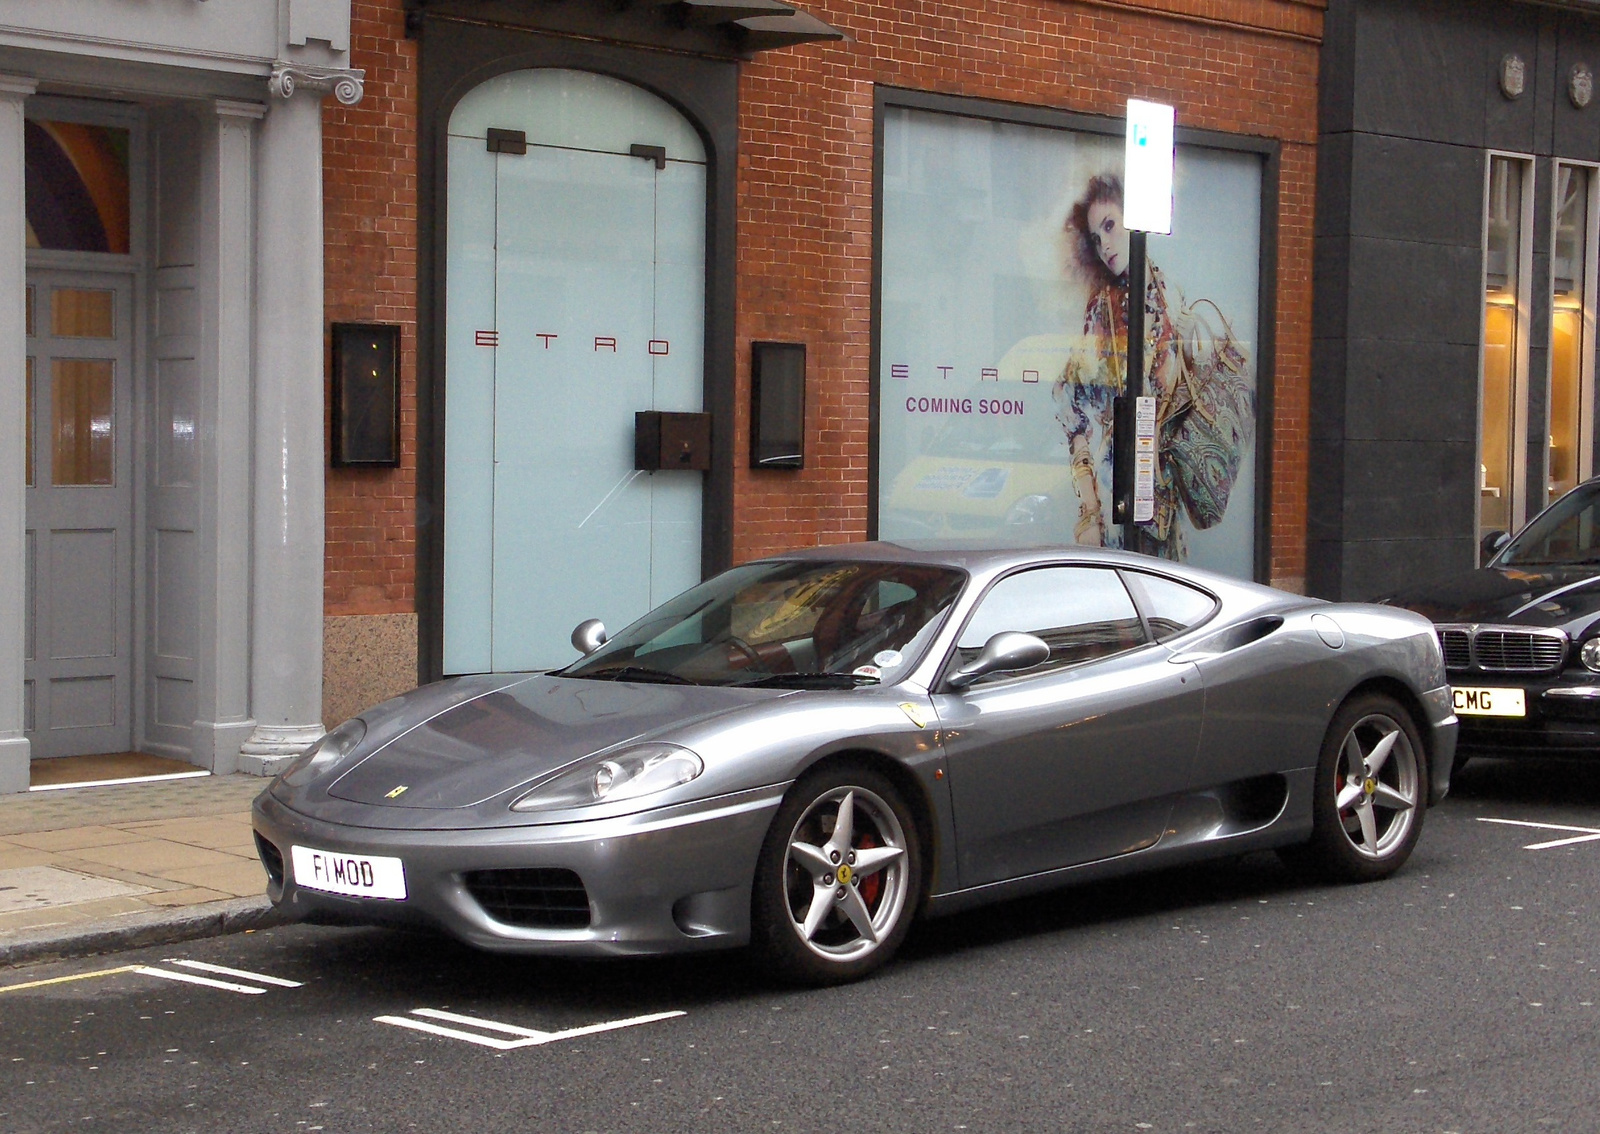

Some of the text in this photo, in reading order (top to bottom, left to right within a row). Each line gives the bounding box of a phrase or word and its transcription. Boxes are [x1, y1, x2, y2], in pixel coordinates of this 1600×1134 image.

[475, 330, 669, 355] ETRO
[891, 364, 1039, 383] ETRO
[906, 397, 1024, 415] COMING SOON
[1453, 690, 1492, 709] CMG
[333, 857, 374, 887] MOD
